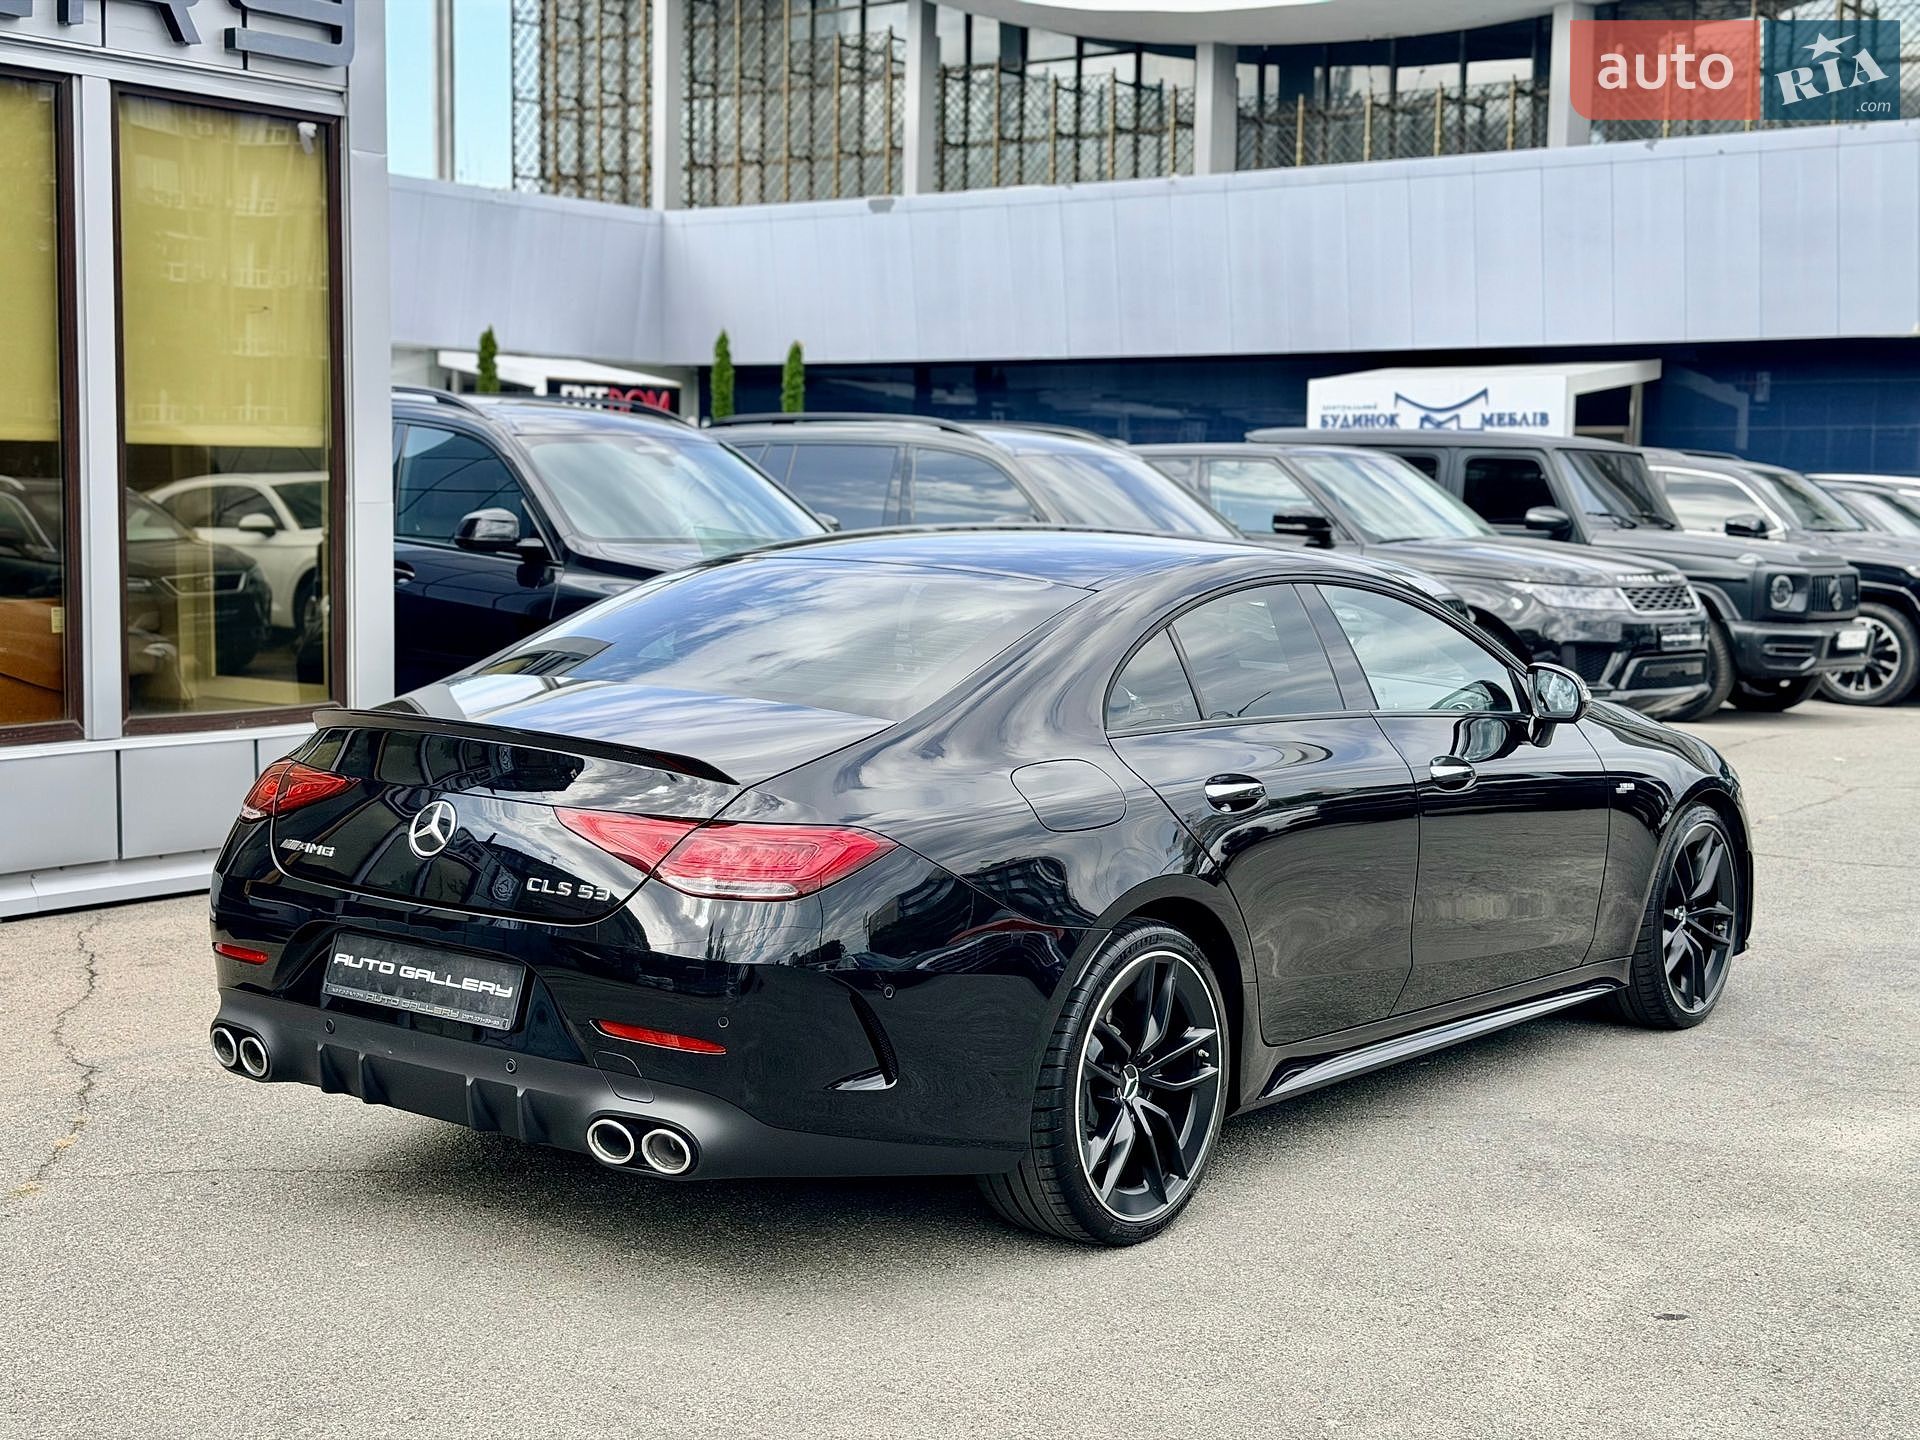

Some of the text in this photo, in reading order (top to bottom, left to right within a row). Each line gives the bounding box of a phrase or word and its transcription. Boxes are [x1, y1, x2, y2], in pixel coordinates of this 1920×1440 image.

[1320, 413, 1399, 429] БУДИНОК
[297, 840, 336, 858] AMG
[526, 877, 612, 902] CLS 53
[333, 952, 514, 998] AUTO GALLERY
[366, 993, 460, 1018] AUTO GALLERY
